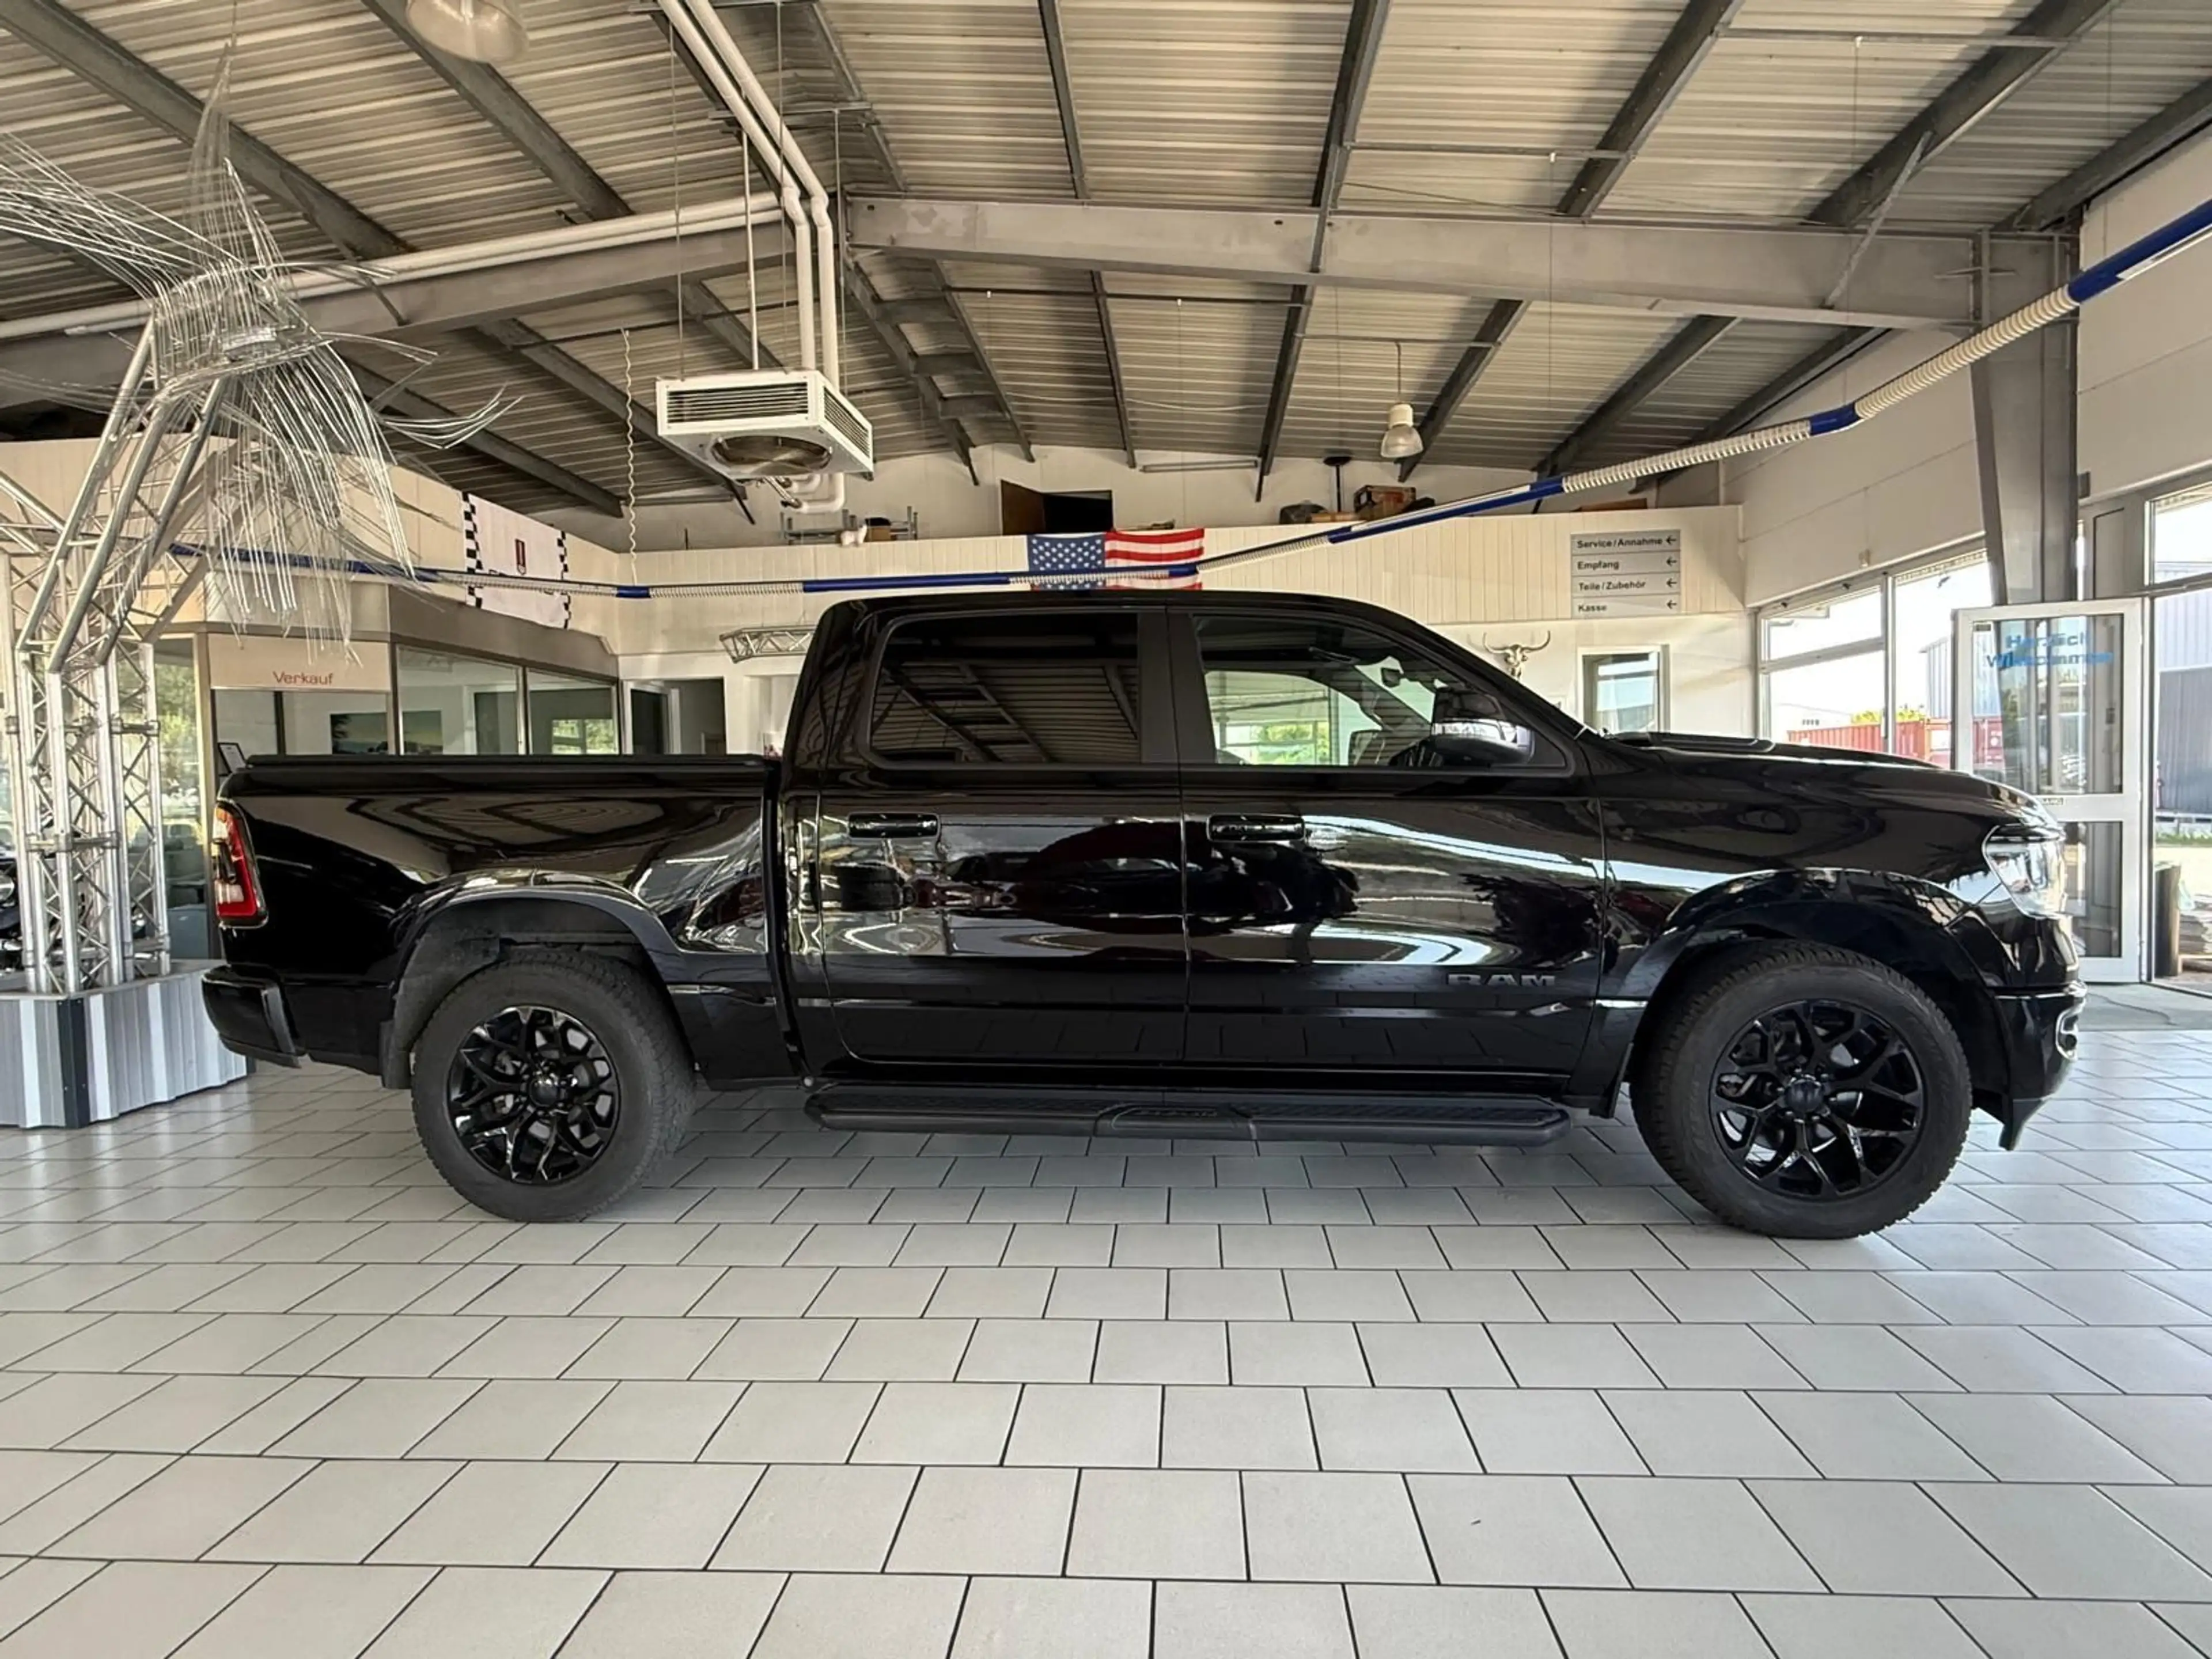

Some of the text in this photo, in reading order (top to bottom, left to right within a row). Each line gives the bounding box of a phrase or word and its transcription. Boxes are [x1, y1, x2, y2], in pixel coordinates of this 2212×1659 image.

[1577, 537, 1663, 548] Service/Annahme
[1577, 560, 1620, 570] Empfang
[1578, 604, 1607, 612] Kasse
[272, 671, 334, 685] Verkauf
[1447, 974, 1555, 986] RAM
